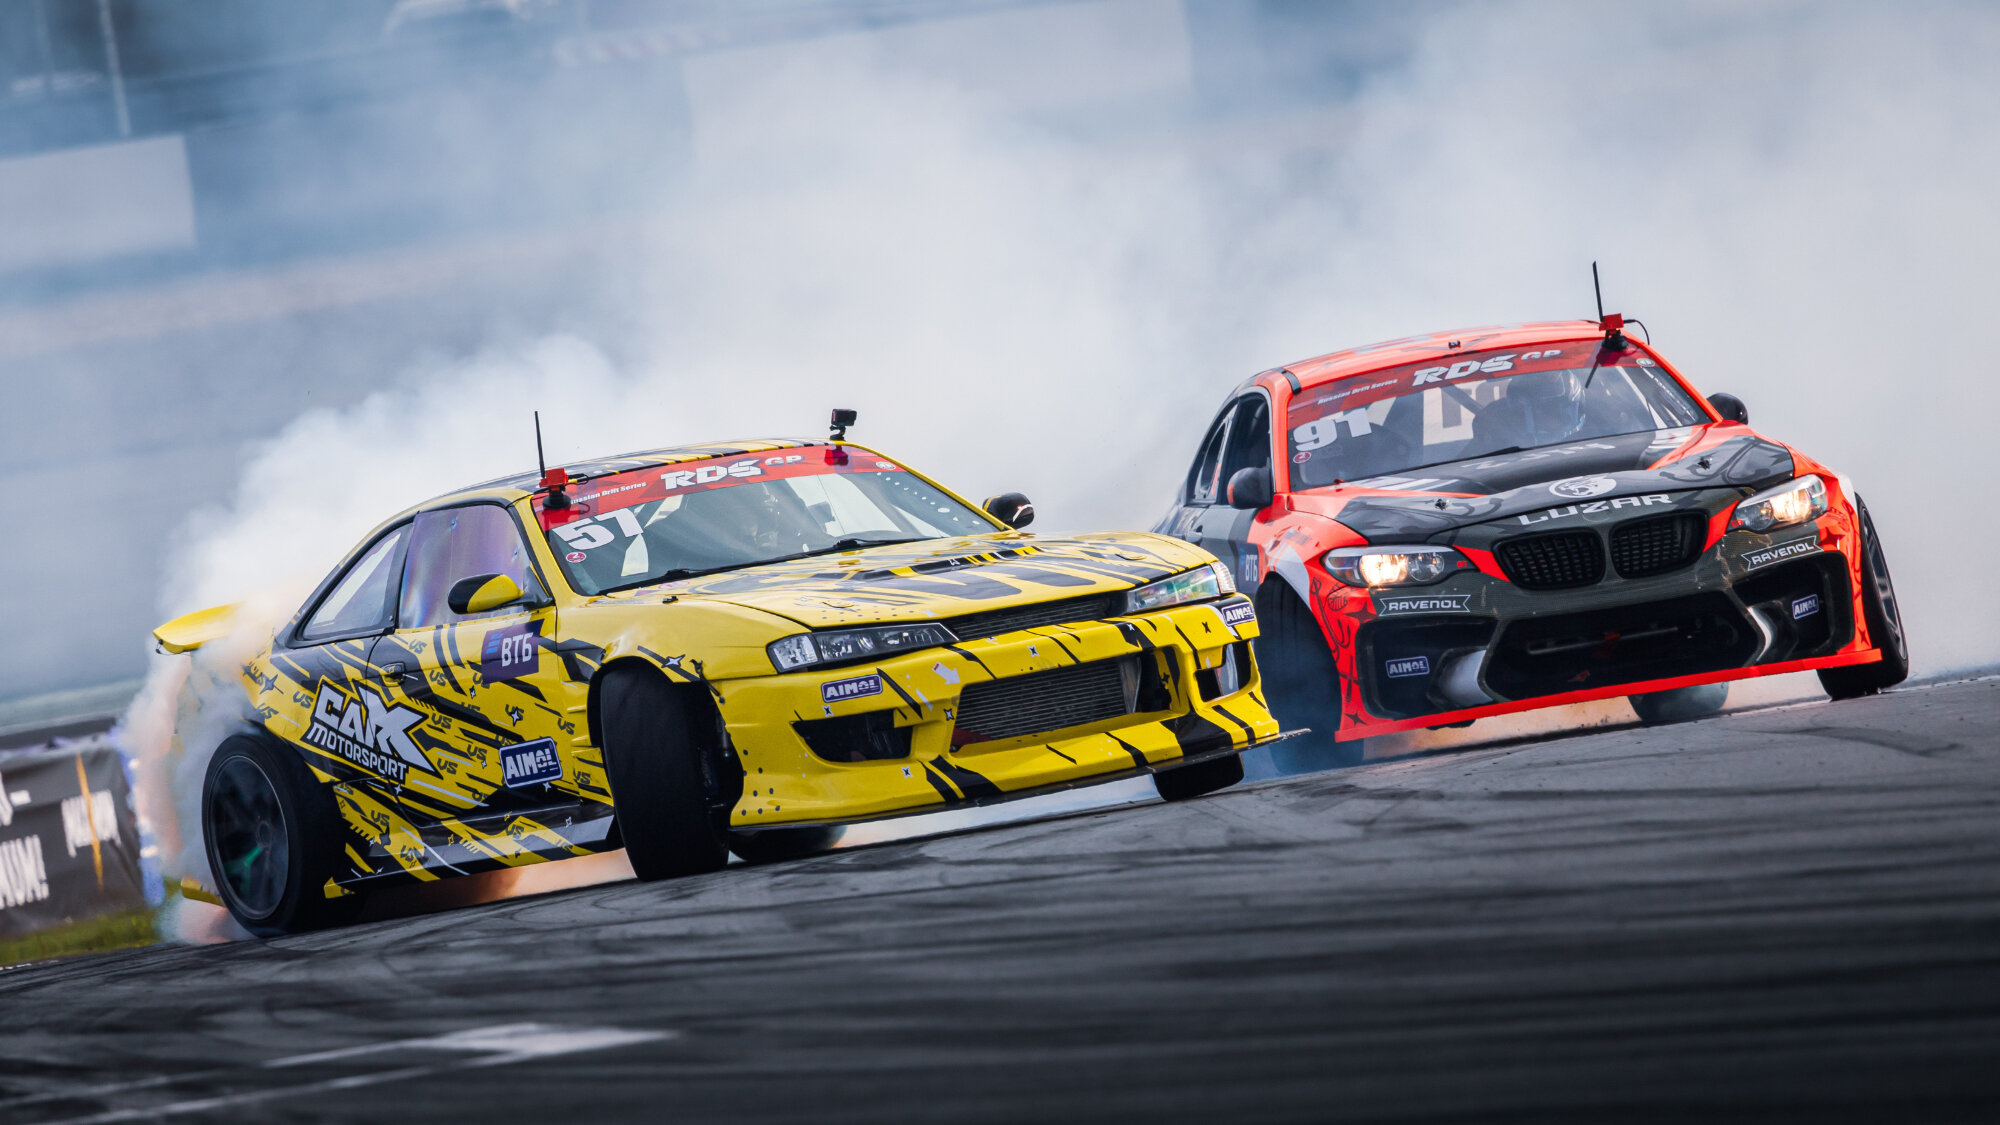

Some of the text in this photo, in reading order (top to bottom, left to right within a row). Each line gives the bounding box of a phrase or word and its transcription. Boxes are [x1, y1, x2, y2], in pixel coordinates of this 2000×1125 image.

[1411, 349, 1562, 387] RDS GP
[1293, 411, 1372, 451] 91
[660, 455, 802, 490] RDS GP
[570, 493, 600, 505] ussian
[1518, 494, 1673, 525] LUZAR
[551, 507, 644, 550] 57
[1751, 542, 1815, 565] RAVENOL
[1388, 600, 1461, 611] RAVENOL
[1794, 599, 1817, 616] AIMOL
[501, 632, 533, 667] ВТБ
[1389, 660, 1428, 675] AIMOL
[825, 679, 879, 699] AIMOL
[306, 722, 407, 781] MOTORSPORT
[505, 748, 558, 780] AIMOL
